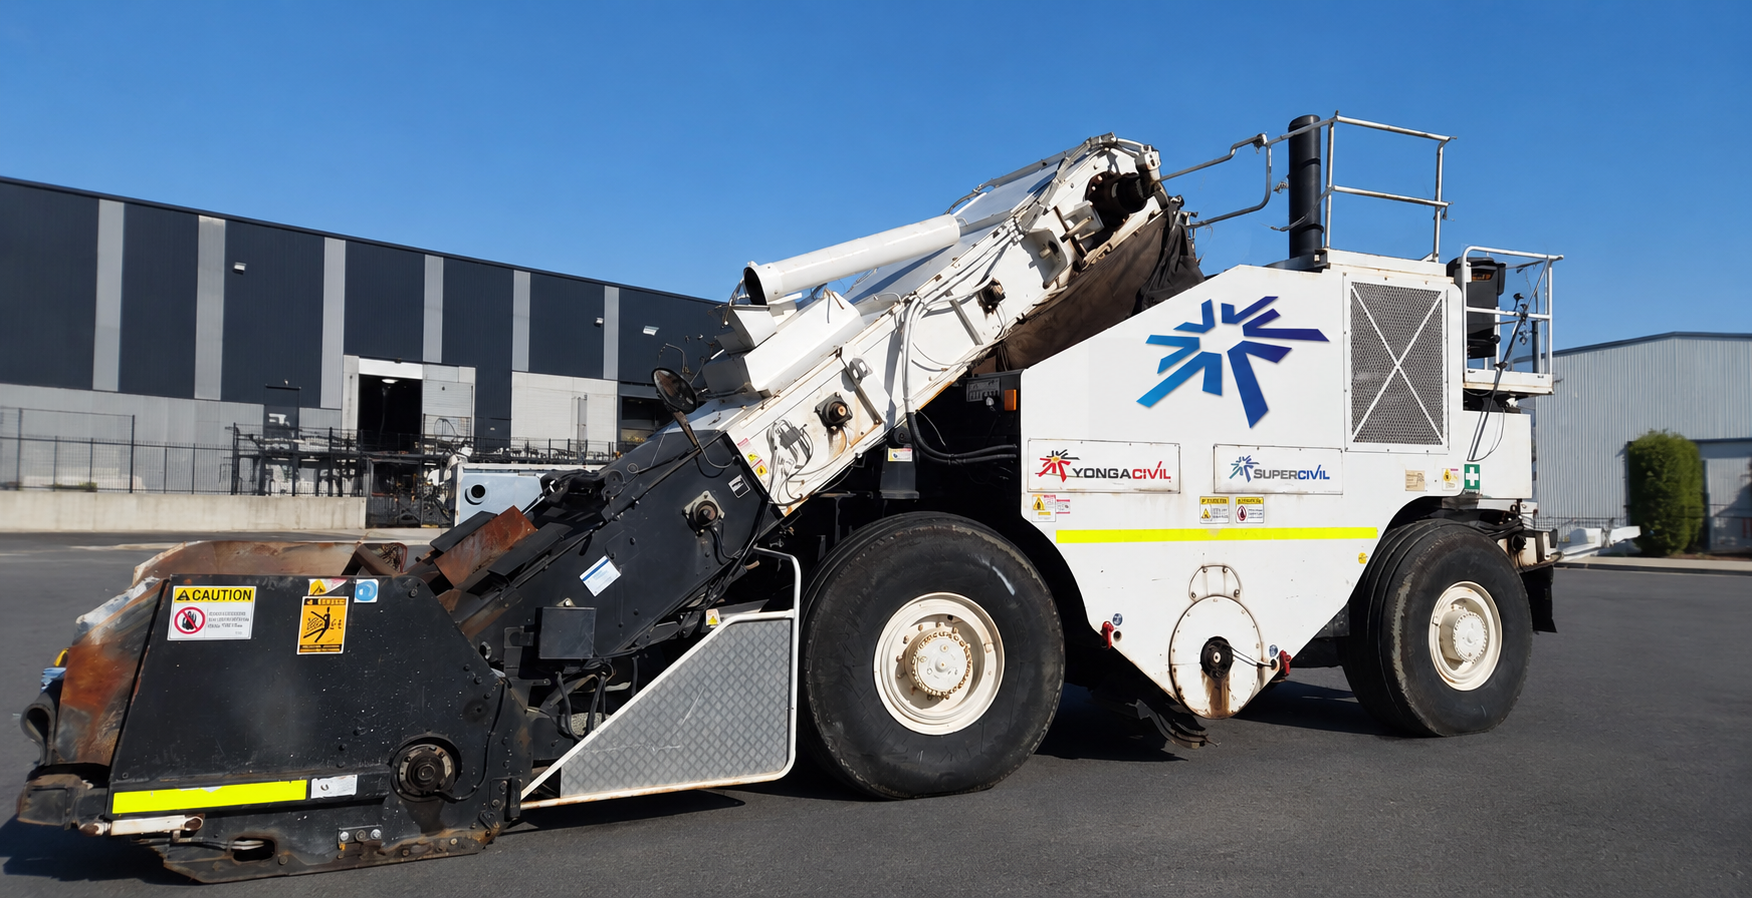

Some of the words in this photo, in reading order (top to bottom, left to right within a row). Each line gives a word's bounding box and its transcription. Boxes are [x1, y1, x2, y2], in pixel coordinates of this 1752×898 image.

[1072, 461, 1171, 480] YONGACIVIL
[1253, 464, 1330, 480] SUPERCIVIL
[192, 589, 252, 601] CAUTION
